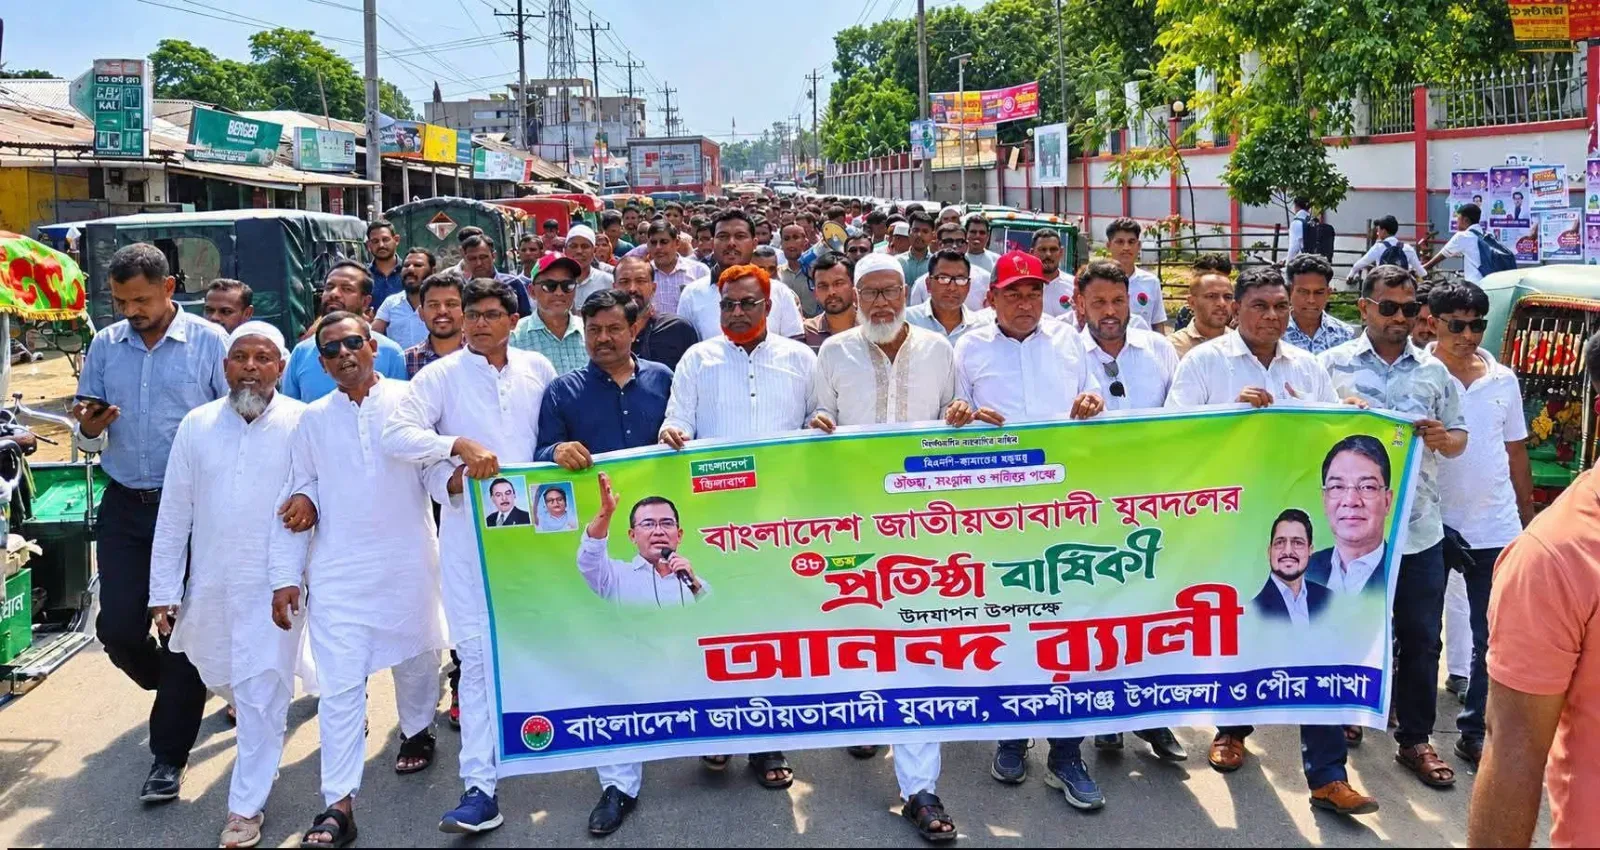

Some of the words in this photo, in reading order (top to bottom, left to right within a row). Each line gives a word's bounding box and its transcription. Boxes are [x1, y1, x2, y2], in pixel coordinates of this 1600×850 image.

[228, 120, 259, 139] BERGER
[701, 513, 863, 552] বাংলাদেশ
[872, 490, 1103, 538] জাতীয়তাবাদী
[1111, 486, 1243, 527] যুবদলের
[796, 558, 822, 571] ৪৮
[821, 552, 986, 612] প্রতিষ্ঠা
[898, 606, 978, 624] উদযাপন
[698, 624, 1011, 682] আনন্দ
[563, 707, 699, 742] বাংলাদেশ
[705, 690, 888, 731] জাতীয়তাবাদী
[895, 695, 989, 726] যুবদল,
[1124, 681, 1221, 707] উপজেলা
[1229, 682, 1247, 700] ও
[1256, 670, 1309, 700] পৌর
[1315, 672, 1370, 699] শাখা
